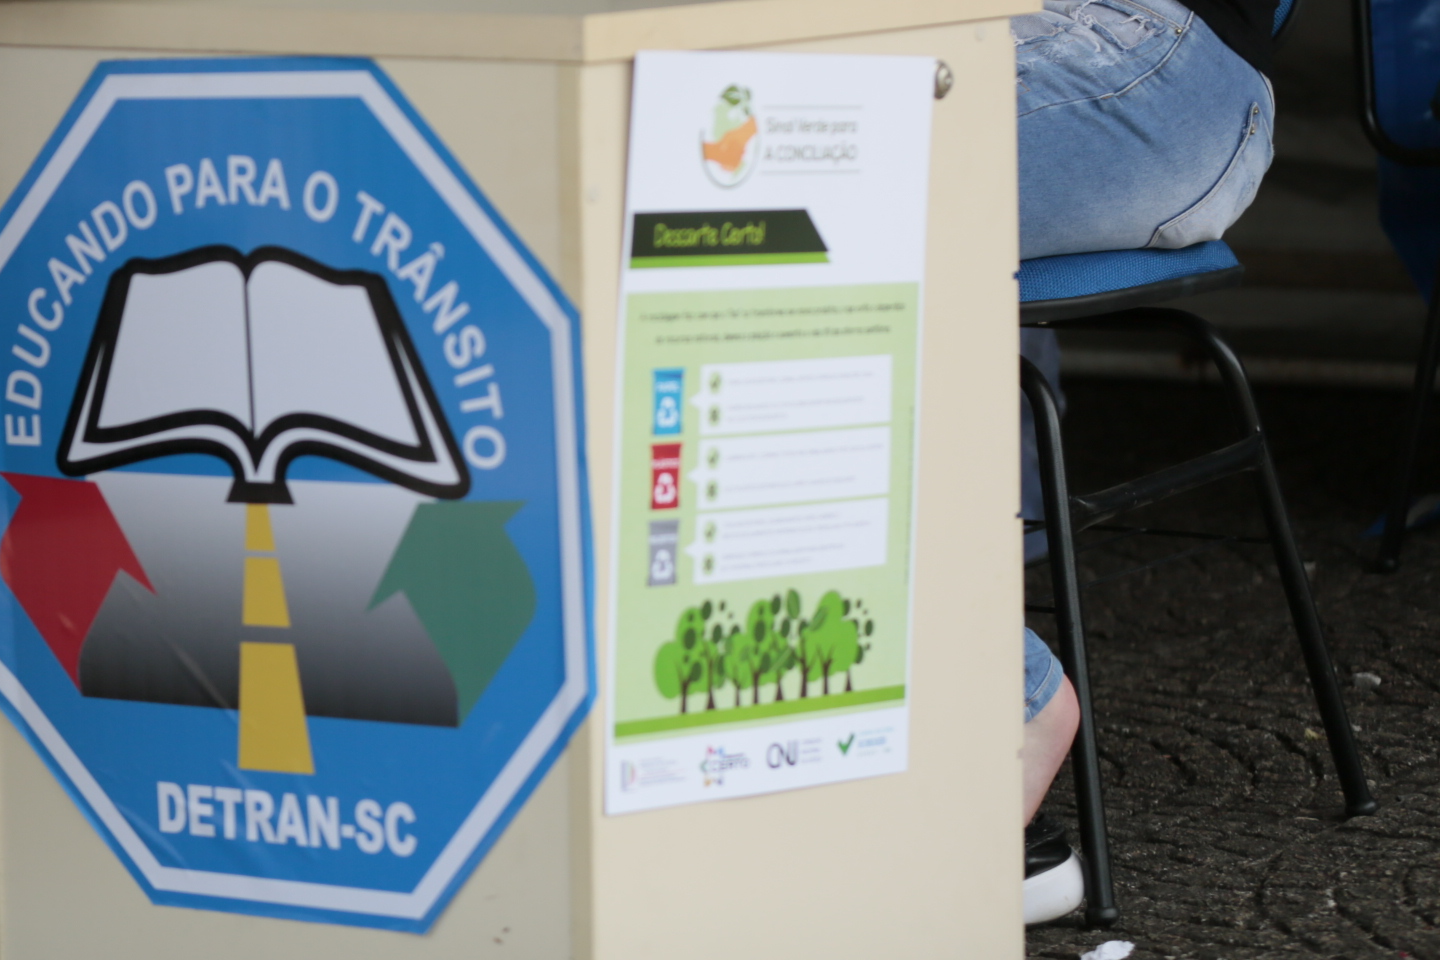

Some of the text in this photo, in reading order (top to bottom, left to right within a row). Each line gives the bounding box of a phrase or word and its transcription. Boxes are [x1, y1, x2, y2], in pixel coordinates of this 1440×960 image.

[798, 116, 829, 134] Verde
[831, 119, 858, 136] para
[765, 144, 774, 161] A
[653, 221, 719, 249] Descarte
[5, 155, 507, 471] EDUCANDO PARA O TRÂNSITO
[156, 780, 419, 858] DETRAN-SC
